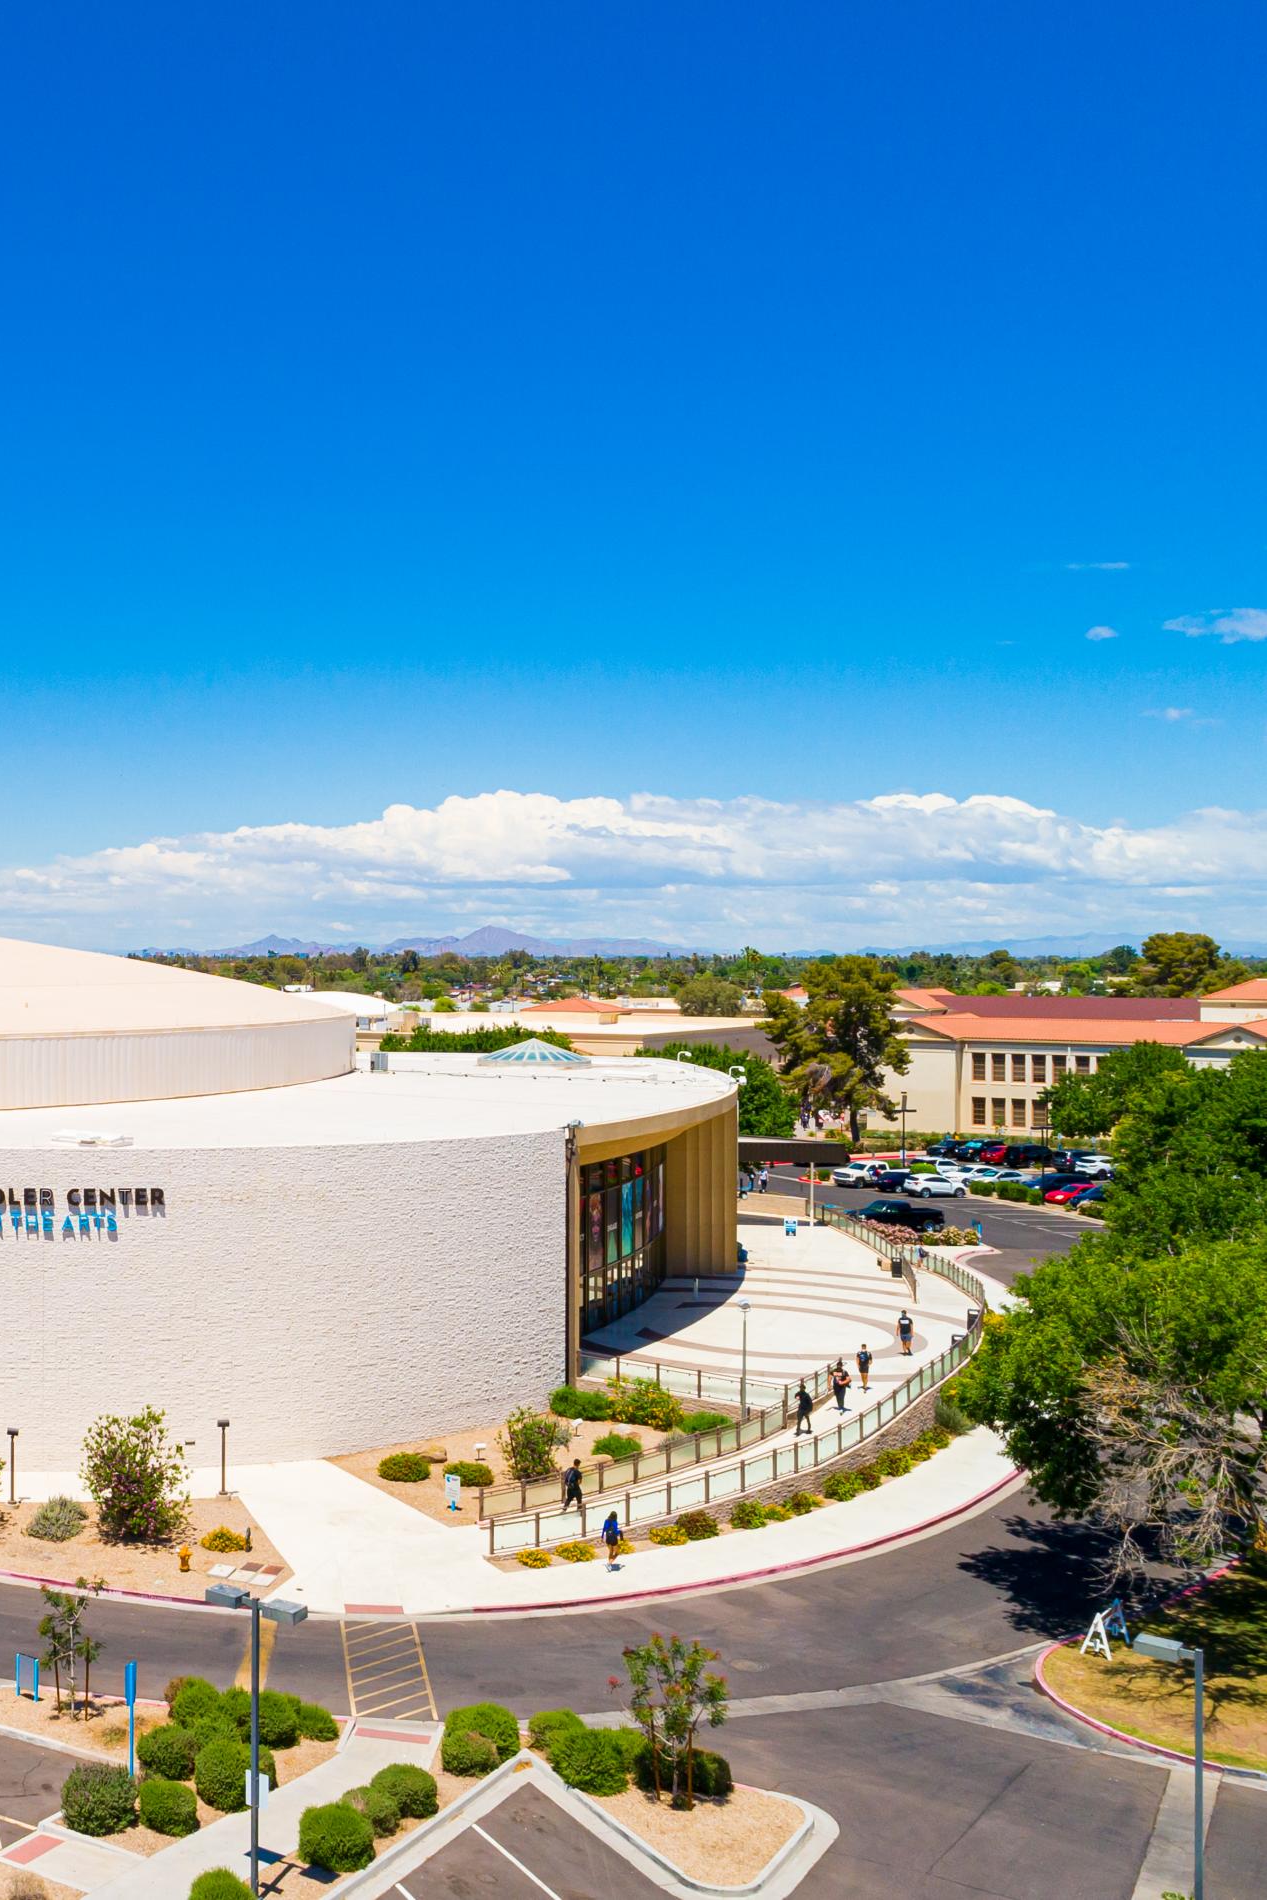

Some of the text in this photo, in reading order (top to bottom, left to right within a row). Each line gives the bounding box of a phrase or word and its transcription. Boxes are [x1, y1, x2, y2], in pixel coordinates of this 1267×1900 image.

[67, 1188, 165, 1206] CENTER
[9, 1210, 53, 1232] THE
[61, 1211, 117, 1232] ARTS
